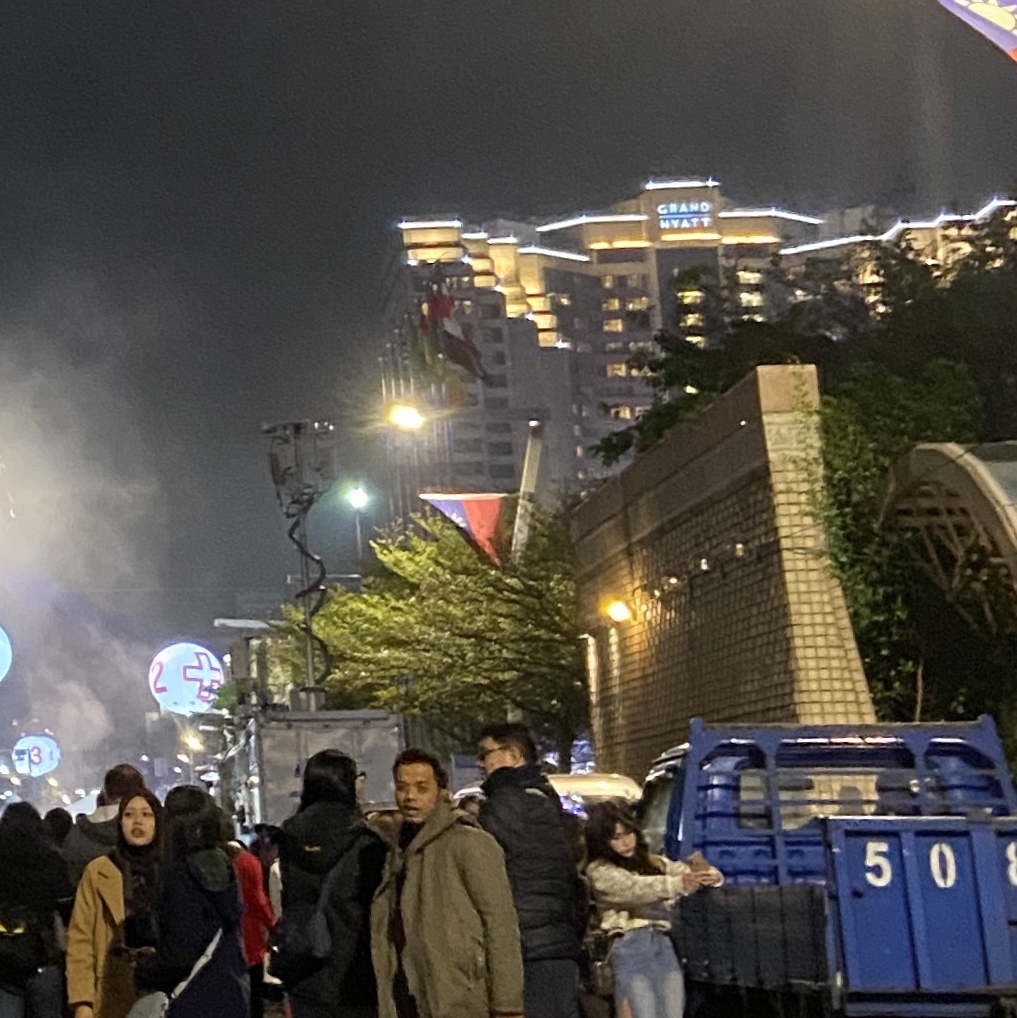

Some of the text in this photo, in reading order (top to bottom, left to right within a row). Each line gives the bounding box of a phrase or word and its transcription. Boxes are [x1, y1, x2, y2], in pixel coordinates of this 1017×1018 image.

[657, 201, 710, 214] GRAND
[660, 217, 711, 229] HYATT
[30, 745, 42, 765] 3
